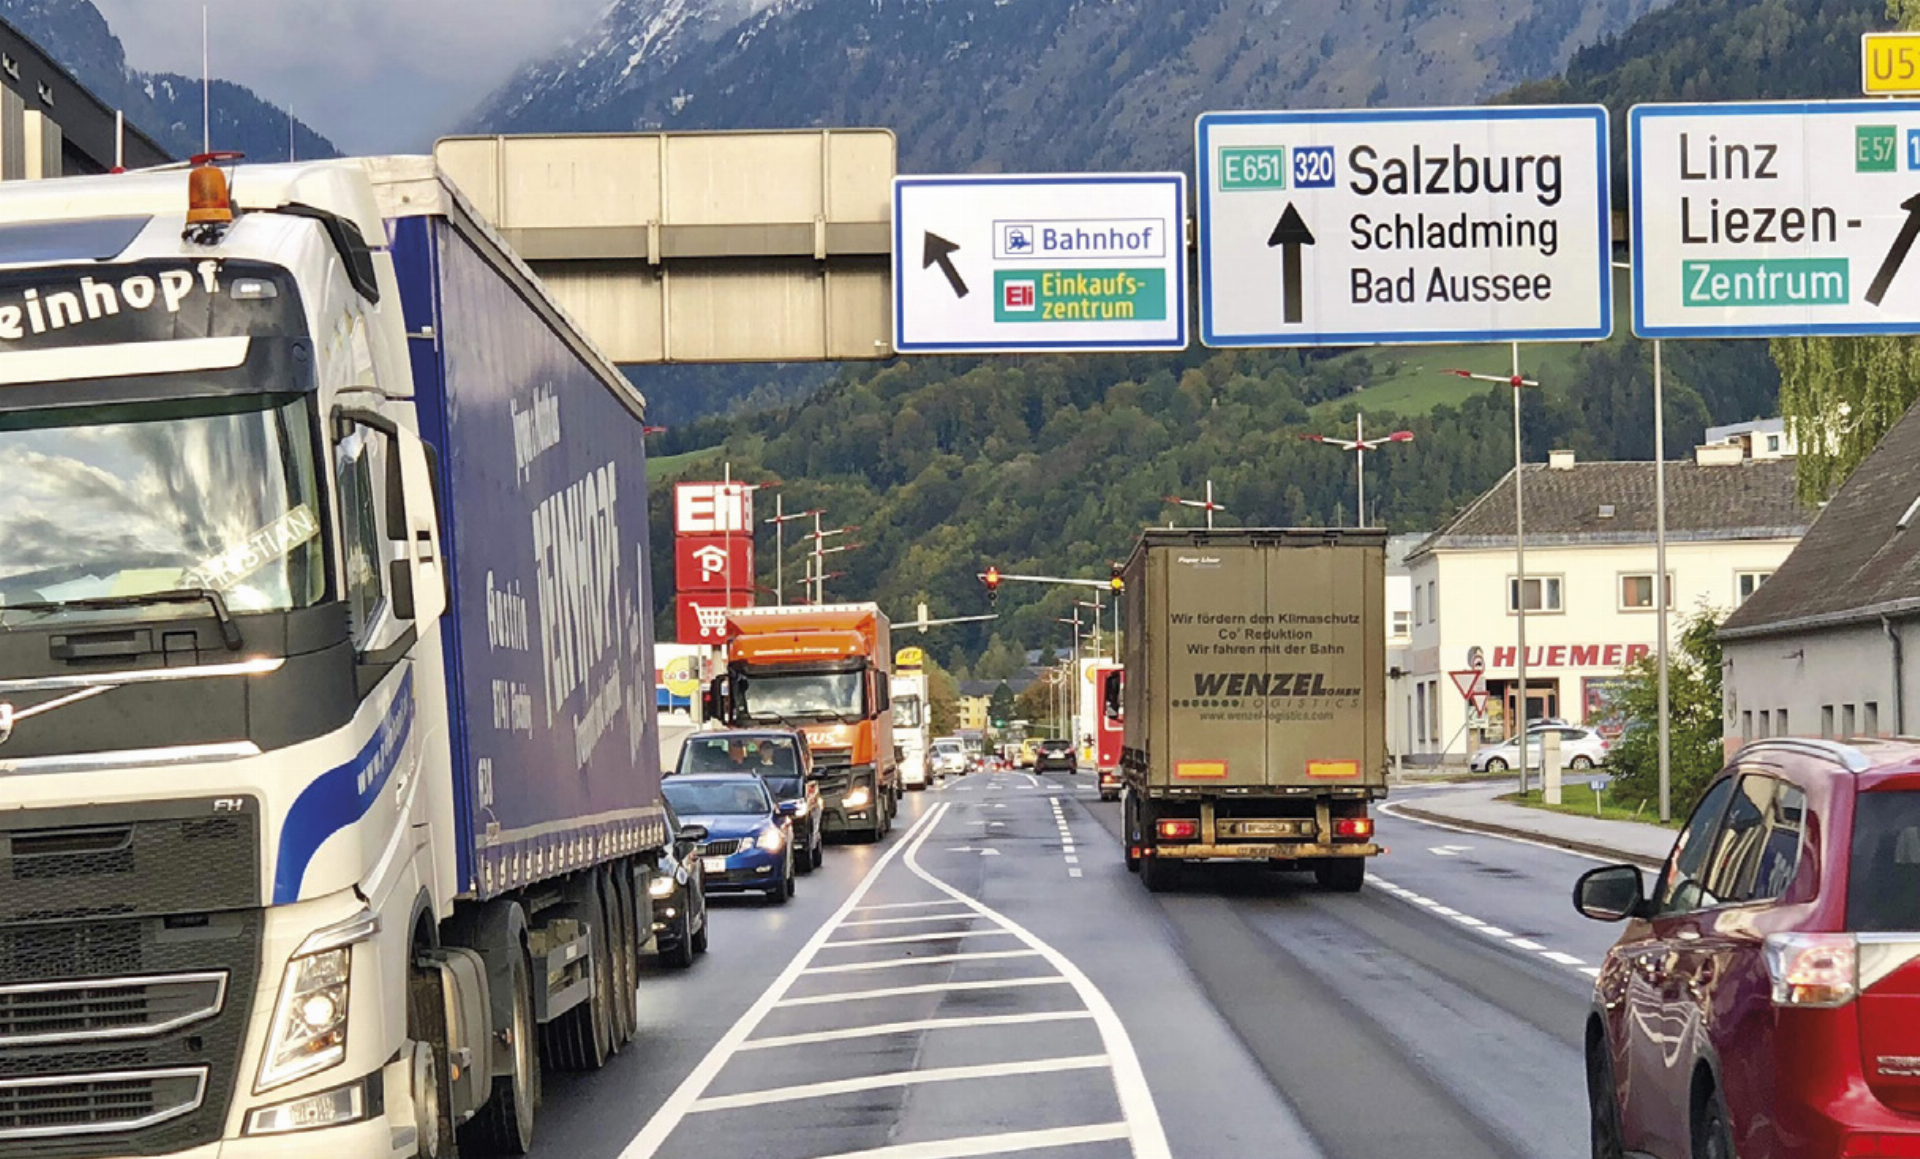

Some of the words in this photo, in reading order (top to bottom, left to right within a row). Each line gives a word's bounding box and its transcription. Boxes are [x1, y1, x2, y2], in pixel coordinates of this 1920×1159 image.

[1873, 48, 1920, 80] U5
[1295, 153, 1333, 182] 320
[1680, 132, 1778, 180] Linz
[1348, 144, 1562, 206] Salzburg
[1681, 197, 1862, 244] Liezen-
[1042, 227, 1154, 251] Bahnhof
[1350, 212, 1558, 256] Schladming
[1041, 272, 1146, 298] Einkaufs-
[1351, 267, 1415, 303] Bad
[1426, 265, 1552, 302] Aussee
[1689, 263, 1843, 301] Zentrum
[1005, 286, 1034, 307] Eli
[1041, 299, 1134, 320] zentrum
[1170, 613, 1193, 625] Wir
[1197, 613, 1246, 625] fördern
[1250, 613, 1274, 625] den
[1278, 613, 1360, 625] Klimaschutz
[1244, 628, 1313, 640] Reduktion
[1187, 643, 1210, 655] Wir
[1213, 643, 1255, 655] fahren
[1259, 643, 1280, 655] mit
[1284, 643, 1306, 655] der
[1310, 643, 1345, 655] Bahn
[1492, 643, 1650, 668] HUEMER
[1193, 673, 1325, 697] WENZEL
[1240, 698, 1360, 709] LOGISTICS
[213, 798, 243, 812] FH
